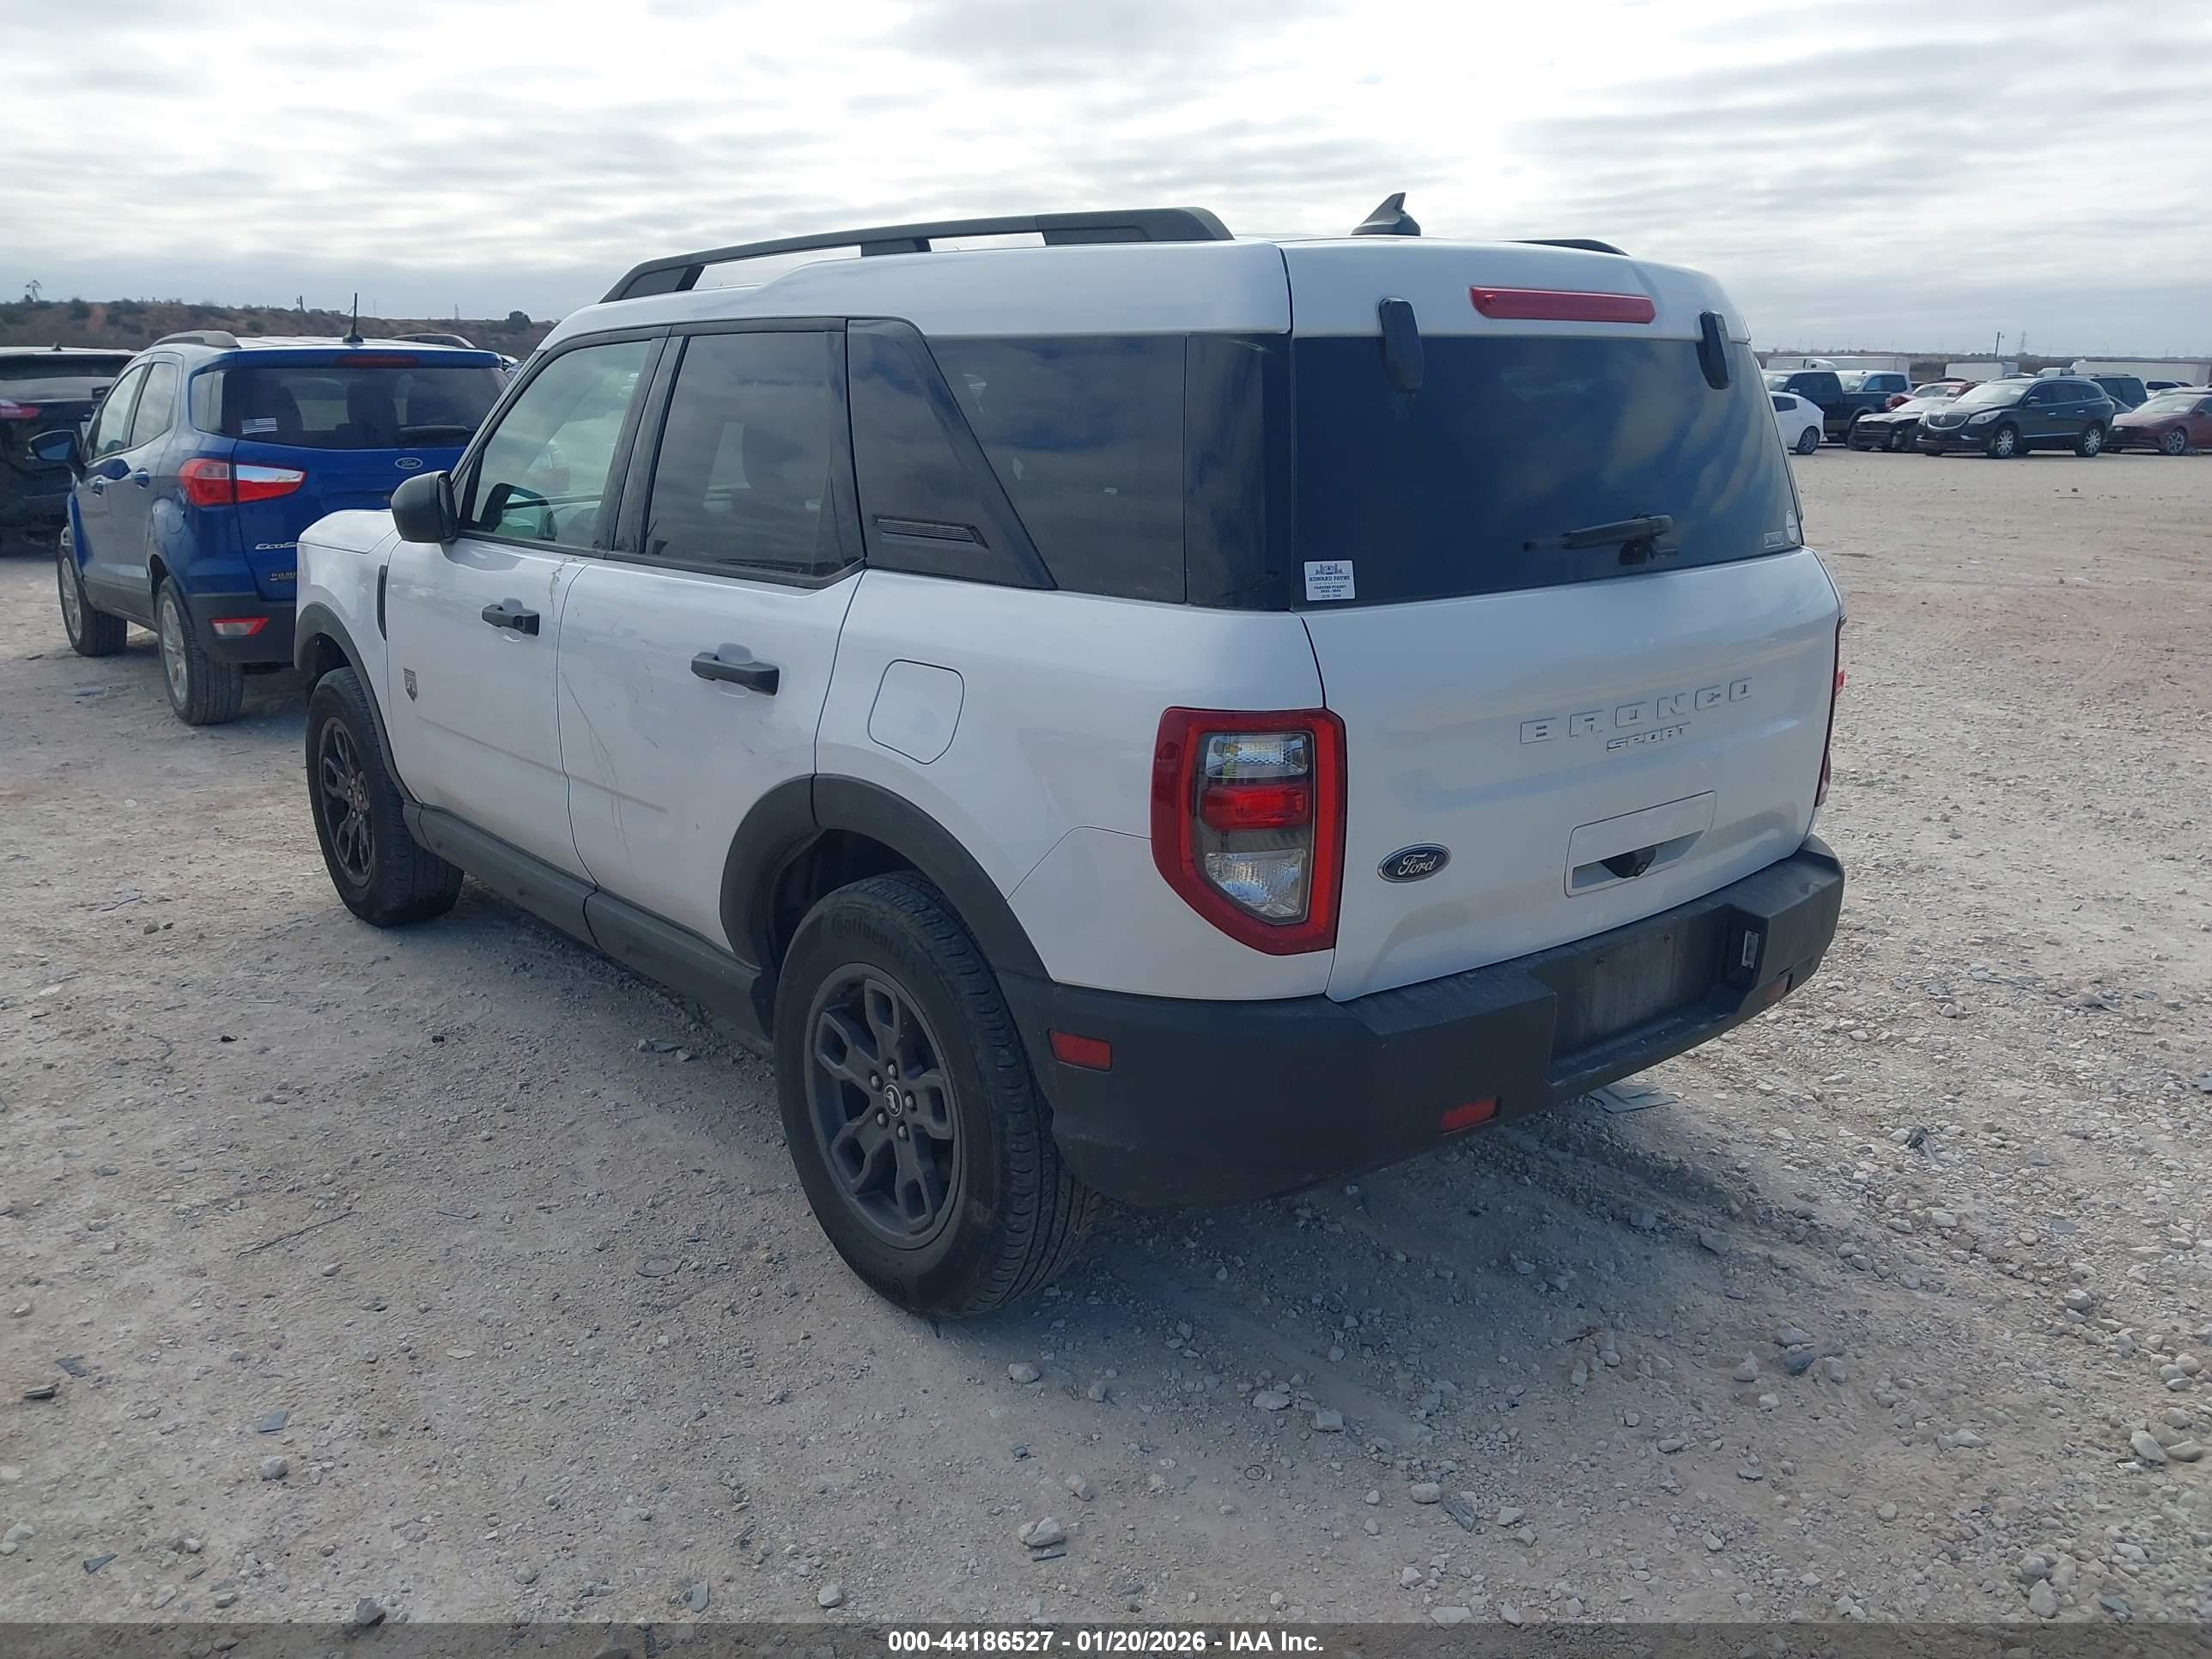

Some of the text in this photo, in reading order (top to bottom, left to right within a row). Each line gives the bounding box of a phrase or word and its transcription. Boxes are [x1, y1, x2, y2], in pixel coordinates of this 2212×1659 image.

[1520, 677, 1753, 744] BRONCO
[1606, 721, 1692, 752] SPORT
[1397, 852, 1437, 876] Ford
